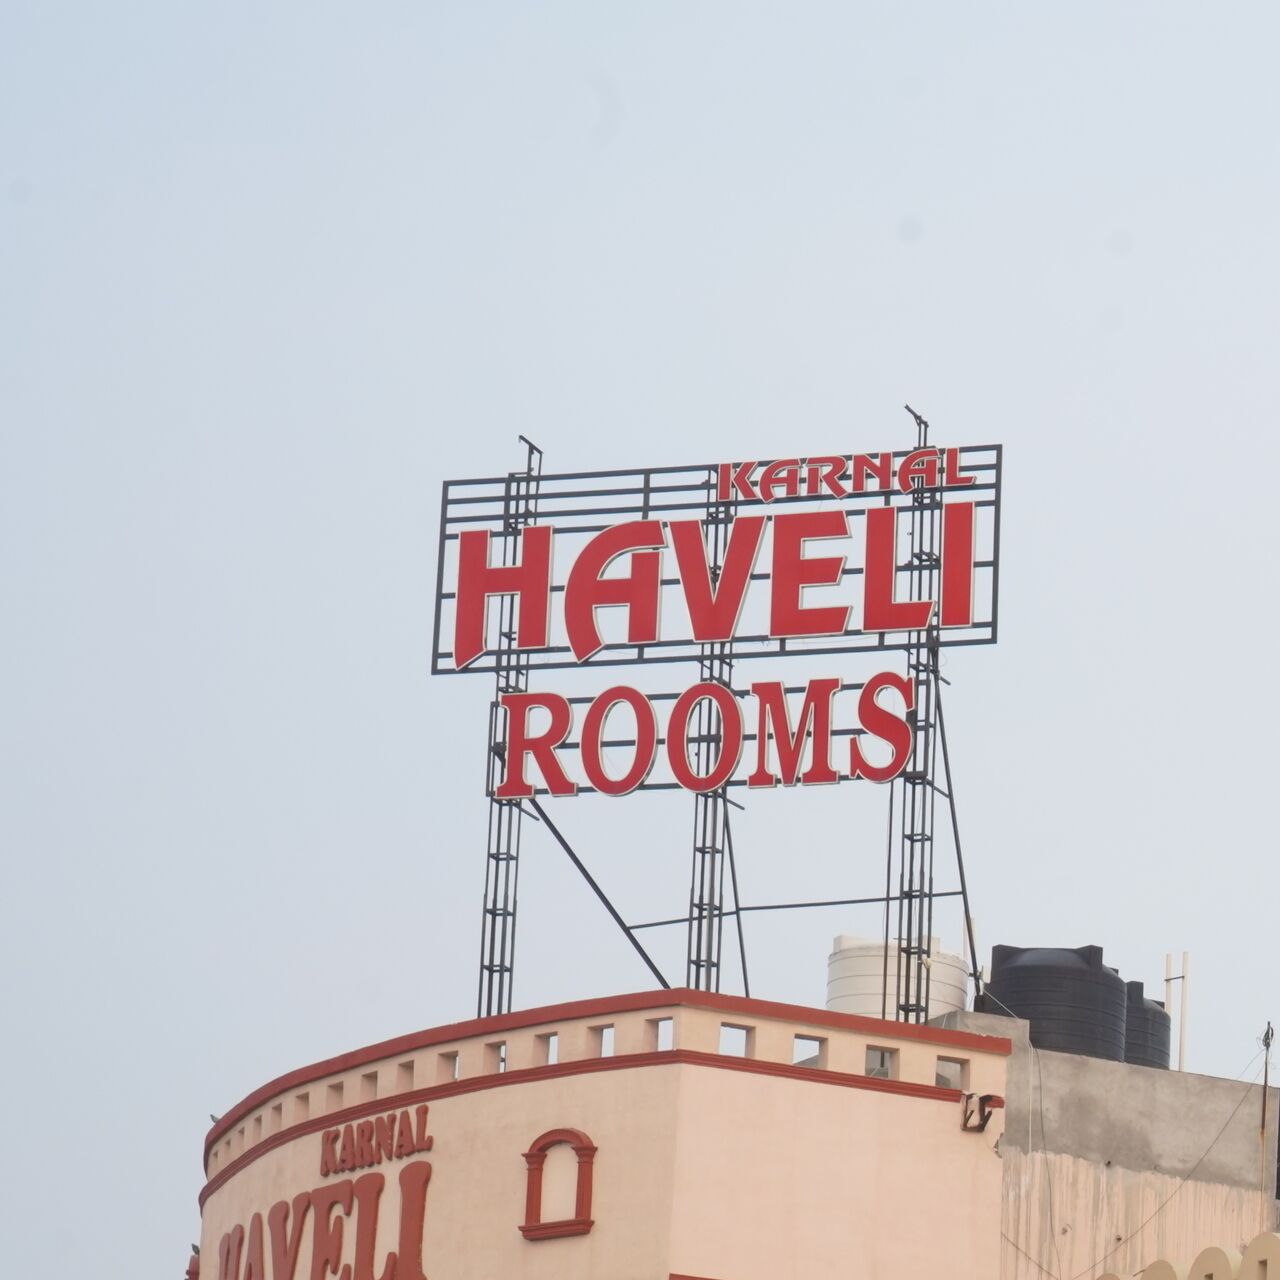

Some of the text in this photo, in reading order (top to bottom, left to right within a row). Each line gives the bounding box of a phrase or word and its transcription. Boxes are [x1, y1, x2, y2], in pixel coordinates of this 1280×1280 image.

[716, 447, 976, 503] KARNAL
[452, 501, 975, 670] HAVELI
[495, 671, 915, 797] ROOMS
[320, 1104, 434, 1177] KARNAL
